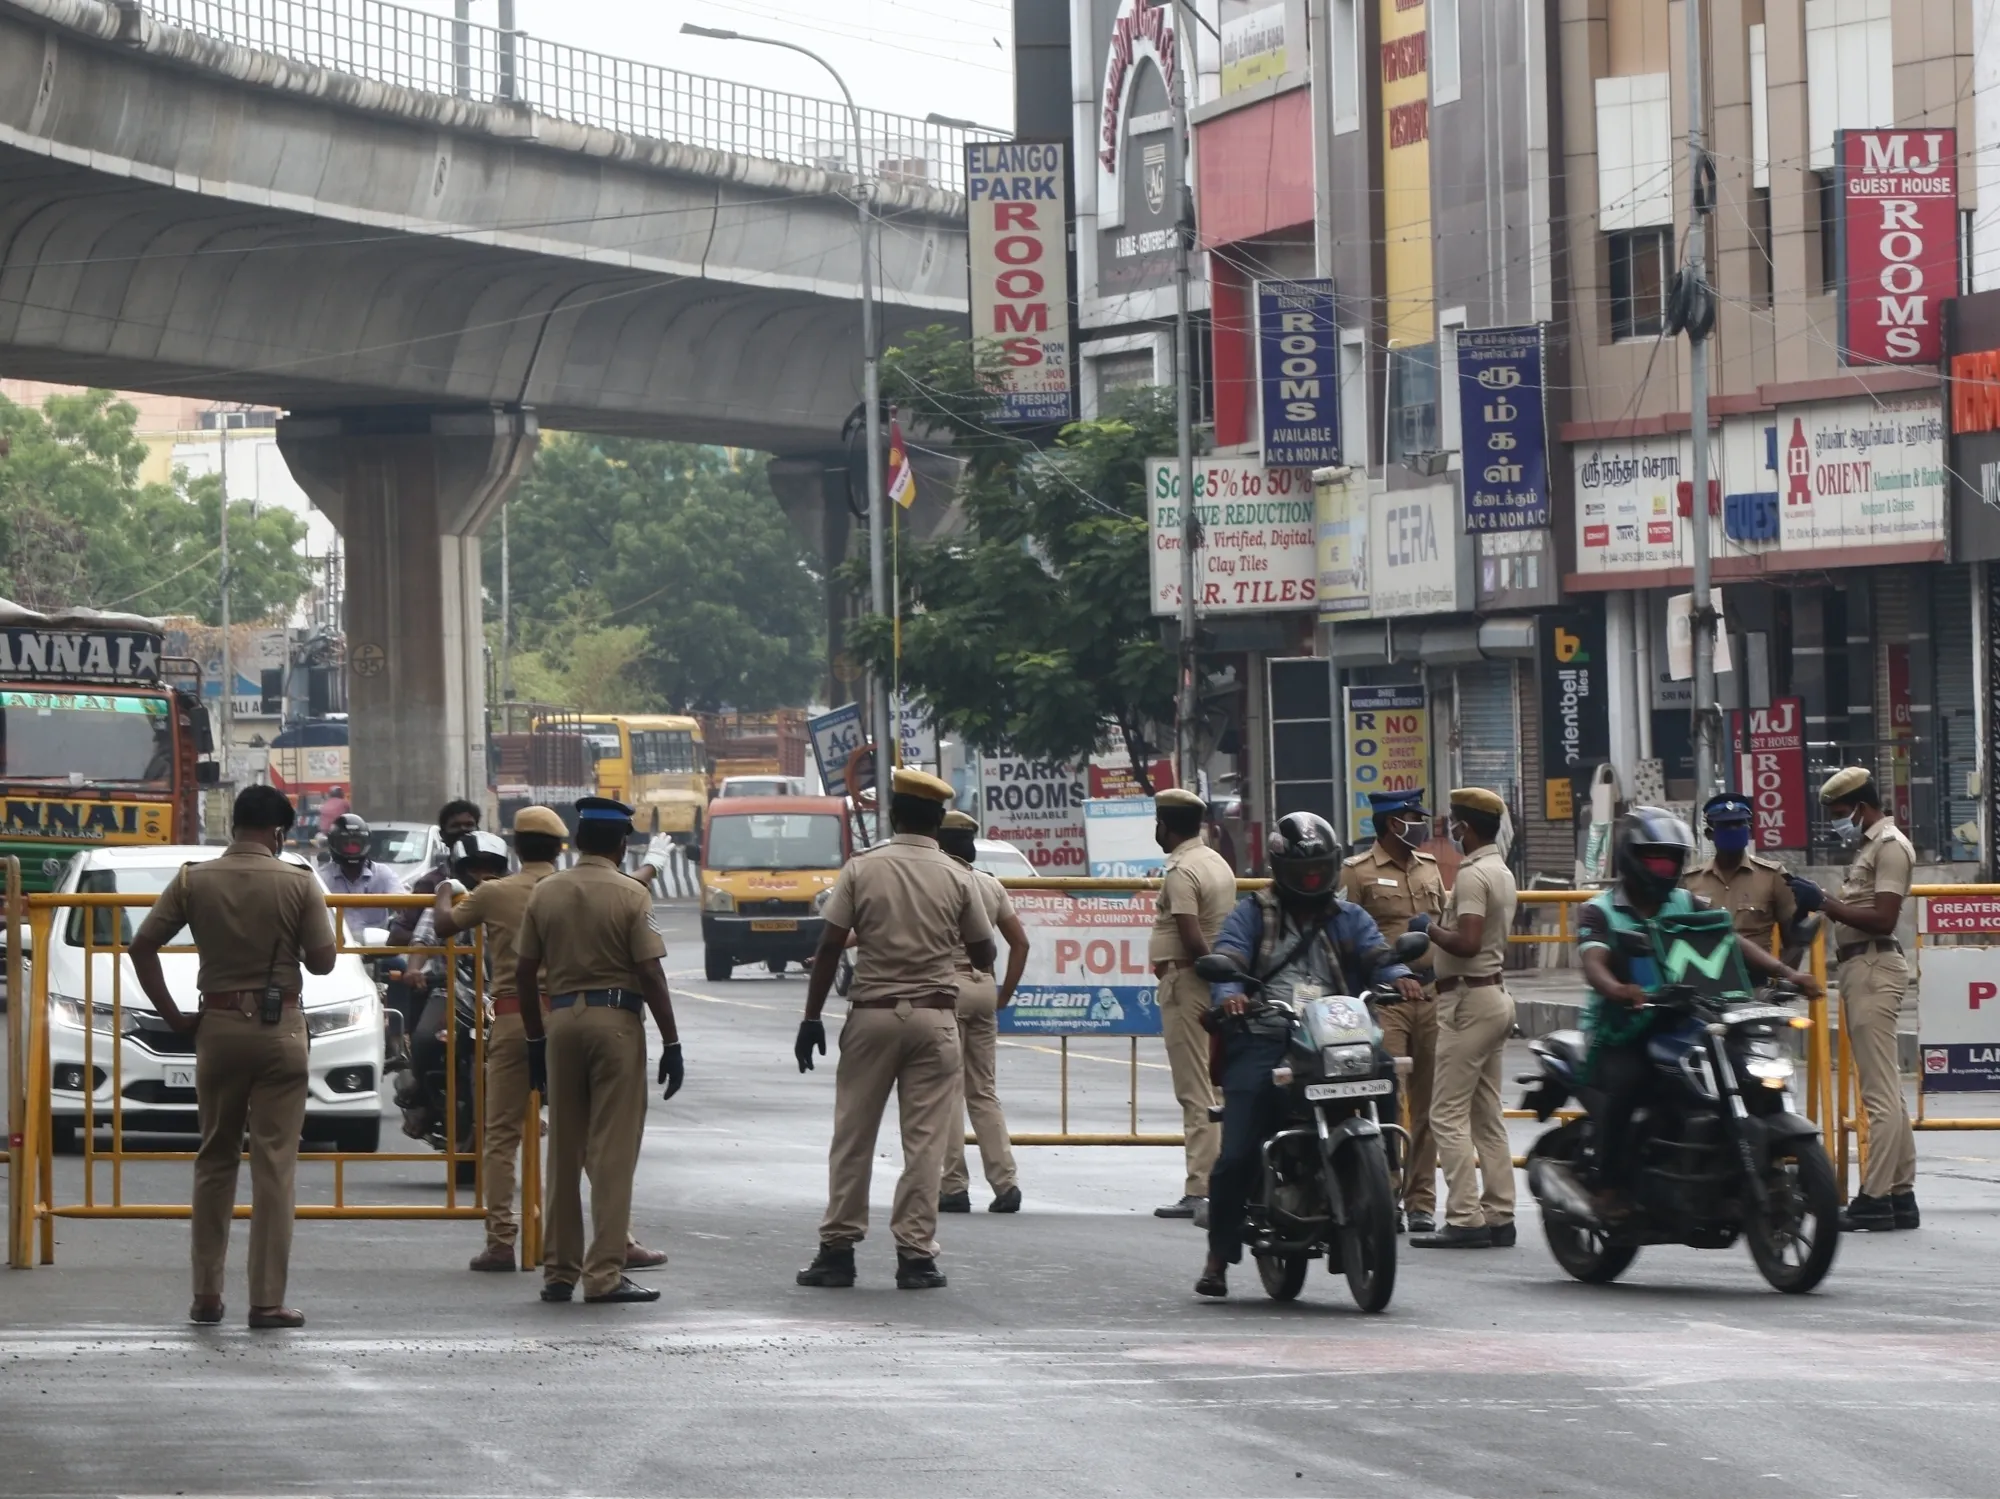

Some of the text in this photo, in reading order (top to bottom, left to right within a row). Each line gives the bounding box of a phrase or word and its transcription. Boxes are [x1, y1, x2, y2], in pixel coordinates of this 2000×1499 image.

[969, 145, 1058, 173] ELANGO
[1861, 135, 1943, 174] MJ
[970, 176, 1057, 201] PARK
[1850, 177, 1950, 194] GUEST HOUSE
[994, 202, 1048, 366] ROOMS
[1877, 200, 1928, 358] ROOMS
[1042, 343, 1064, 353] NON
[1280, 313, 1320, 421] ROOMS
[1042, 382, 1066, 391] 1100
[1012, 394, 1067, 405] FRESHUP
[1273, 428, 1331, 443] AVAILABLE
[1267, 447, 1338, 463] A/C & NON A/C
[1155, 466, 1312, 499] Sae 5% to 50%
[1816, 461, 1871, 496] ORIENT
[1472, 488, 1538, 508] கிடைக்கும்
[1225, 502, 1314, 526] REDUCTION
[1467, 509, 1546, 529] A/C & NON A/C
[1214, 531, 1267, 551] Virtified,
[1271, 529, 1315, 549] Digital,
[1387, 504, 1438, 567] CERA
[1208, 555, 1268, 576] Clay Tiles
[1234, 578, 1316, 603] TILES
[1577, 669, 1589, 696] tiles
[1661, 691, 1676, 701] SRI
[1386, 715, 1418, 734] NO
[1768, 735, 1799, 747] HOUSE
[1388, 747, 1416, 757] DIRECT
[999, 762, 1067, 782] PARK
[1382, 759, 1424, 770] CUSTOMER
[986, 782, 1085, 812] ROOMS
[1756, 754, 1786, 846] ROOMS
[1010, 811, 1068, 822] AVAILABLE
[1009, 896, 1074, 910] GREATER
[1932, 902, 2000, 914] GREATER
[1095, 914, 1136, 923] GUINDY
[1938, 917, 1975, 928] K-10
[1969, 982, 1997, 1009] P
[172, 1071, 192, 1083] TN
